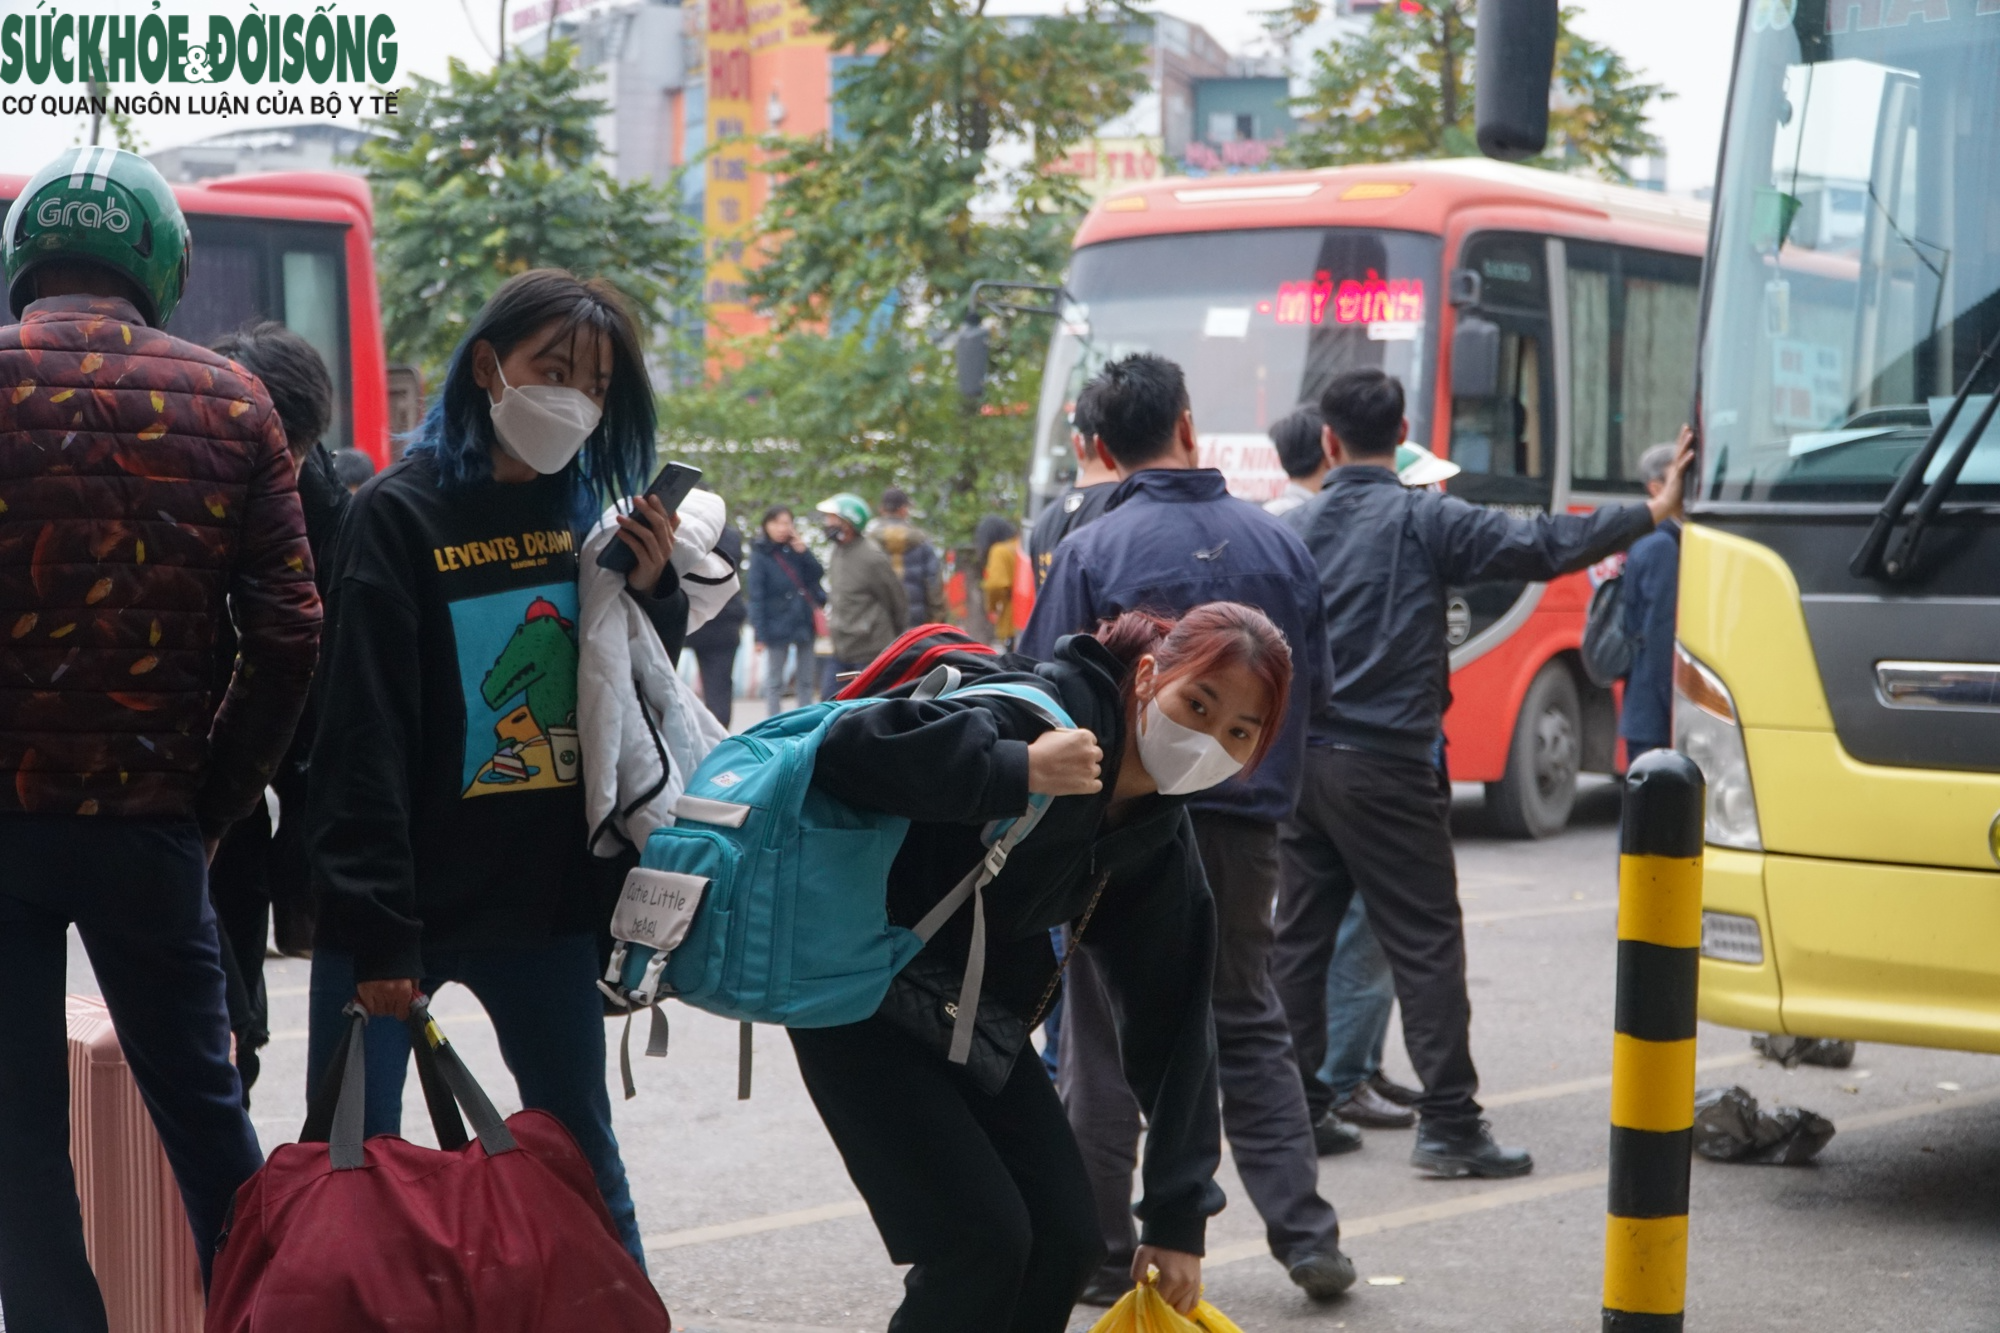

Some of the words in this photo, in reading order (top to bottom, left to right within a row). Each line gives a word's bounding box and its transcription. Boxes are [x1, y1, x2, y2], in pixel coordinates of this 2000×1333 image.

[37, 196, 130, 233] Grab
[1197, 439, 1233, 470] ÁC
[1240, 446, 1283, 471] NIN
[434, 537, 519, 572] LEVENTS
[522, 530, 573, 557] DRAWI
[649, 885, 686, 911] Little
